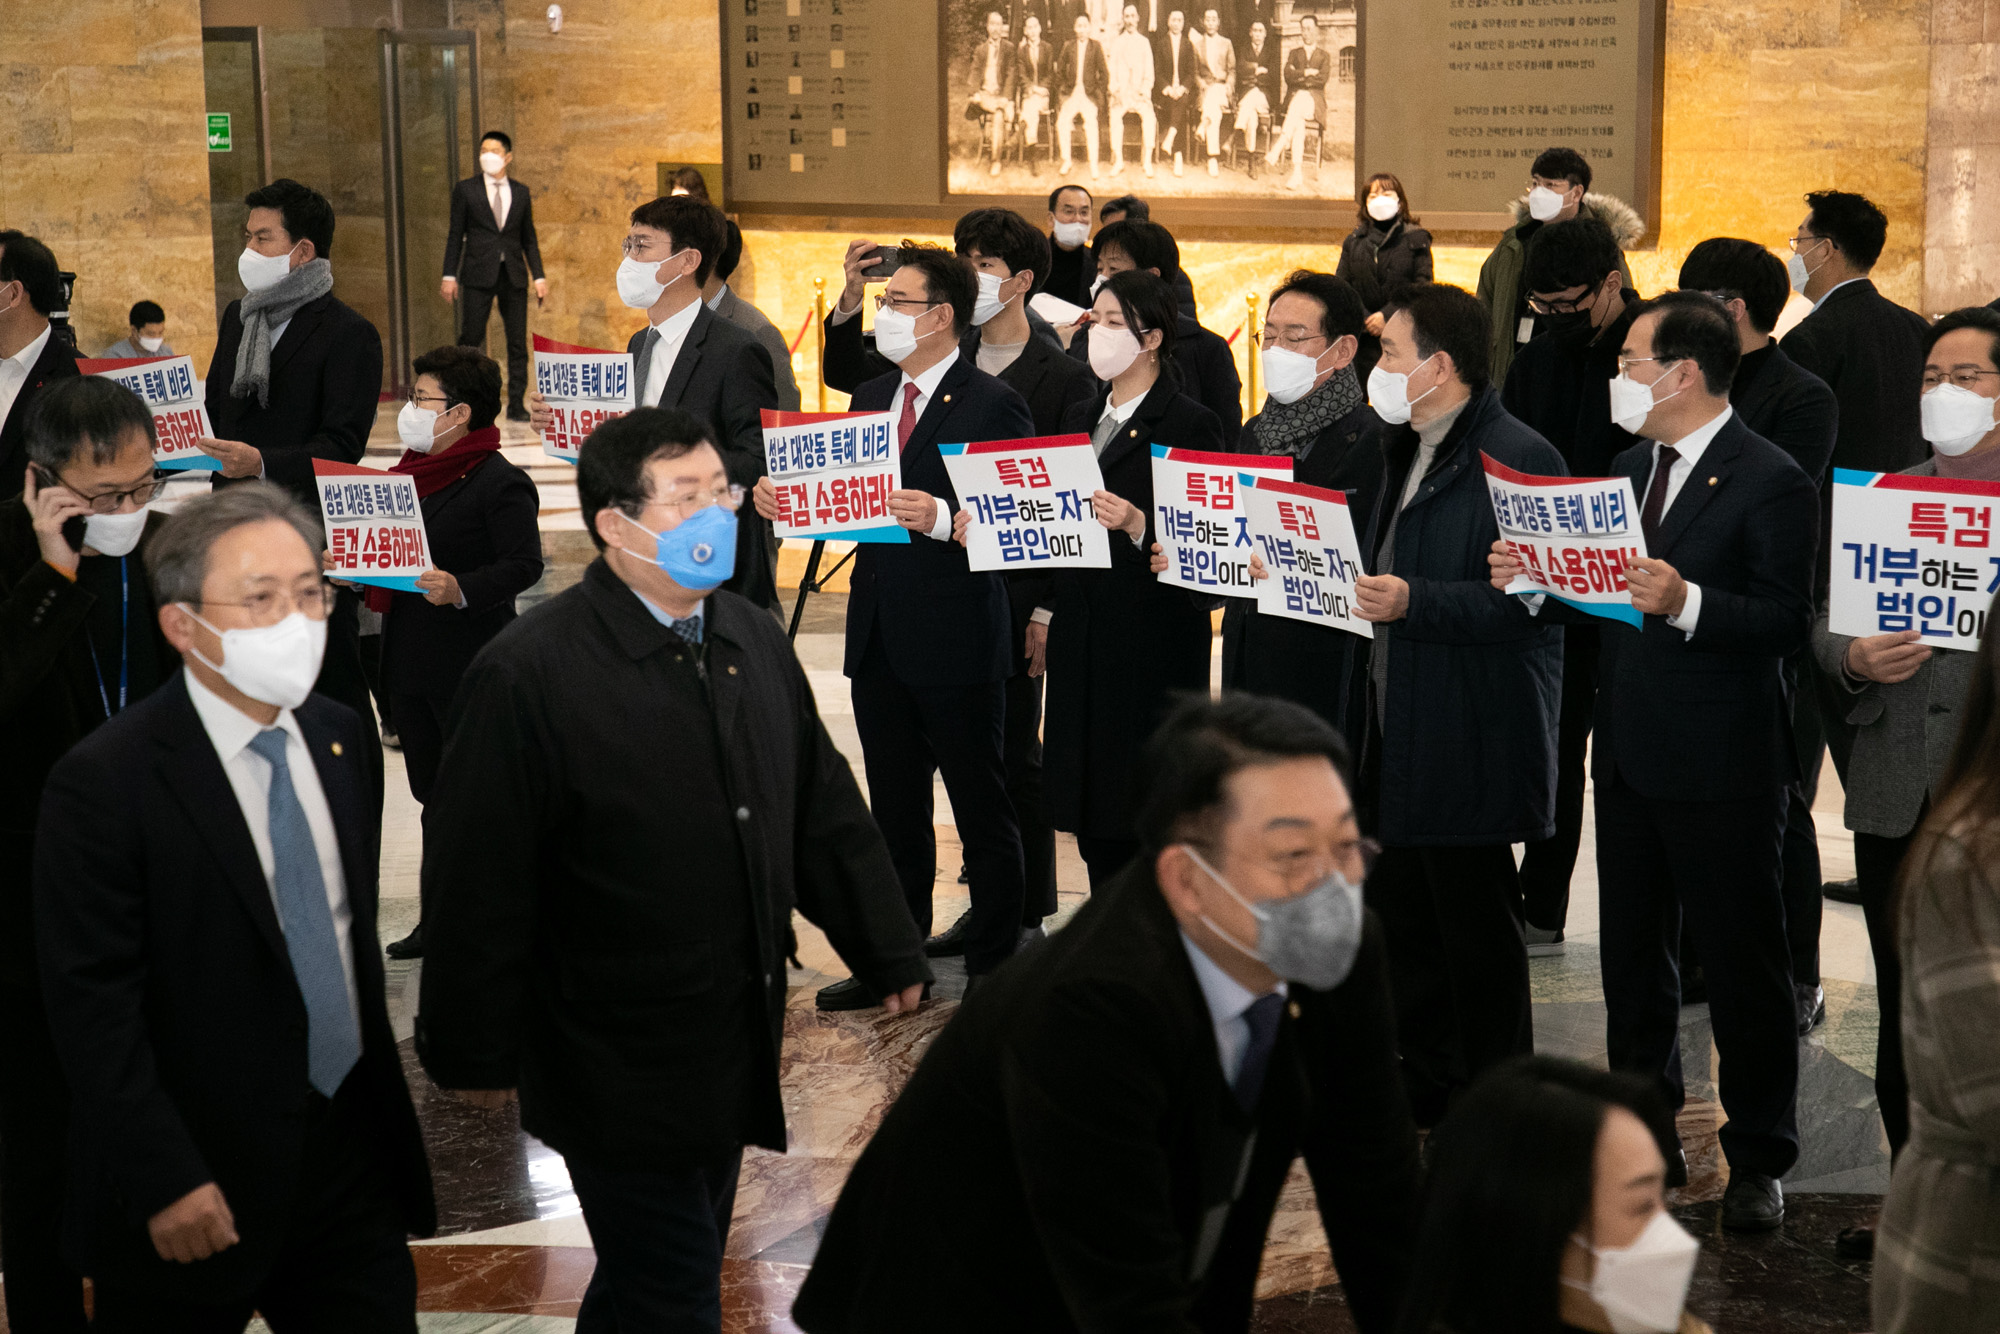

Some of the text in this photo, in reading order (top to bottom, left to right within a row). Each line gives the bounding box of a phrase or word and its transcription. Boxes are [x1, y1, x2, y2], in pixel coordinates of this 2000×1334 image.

[143, 369, 169, 403] 특혜
[167, 364, 194, 399] 비리
[538, 361, 628, 397] 성남 대장동 특혜 비리
[153, 408, 205, 455] 용하라!
[769, 421, 890, 473] 성남 대장동 특혜 비리
[995, 456, 1052, 489] 특검
[1186, 472, 1234, 510] 특검
[325, 482, 416, 516] 성남 대장동 특혜 비리
[775, 483, 811, 528] 특검
[966, 494, 1055, 526] 거부하는
[1492, 486, 1629, 534] 성남 대장동 특혜 비리
[1158, 505, 1229, 547] 거부하는
[1276, 501, 1321, 541] 특검
[1908, 502, 1992, 549] 특검
[332, 526, 426, 569] 특검 수용하라!
[997, 526, 1083, 563] 범인이다
[1255, 534, 1359, 584] 거부하는 자가
[1842, 542, 1979, 592] 거부하는
[1282, 575, 1350, 621] 범인이다
[1876, 591, 1985, 640] 범인이
